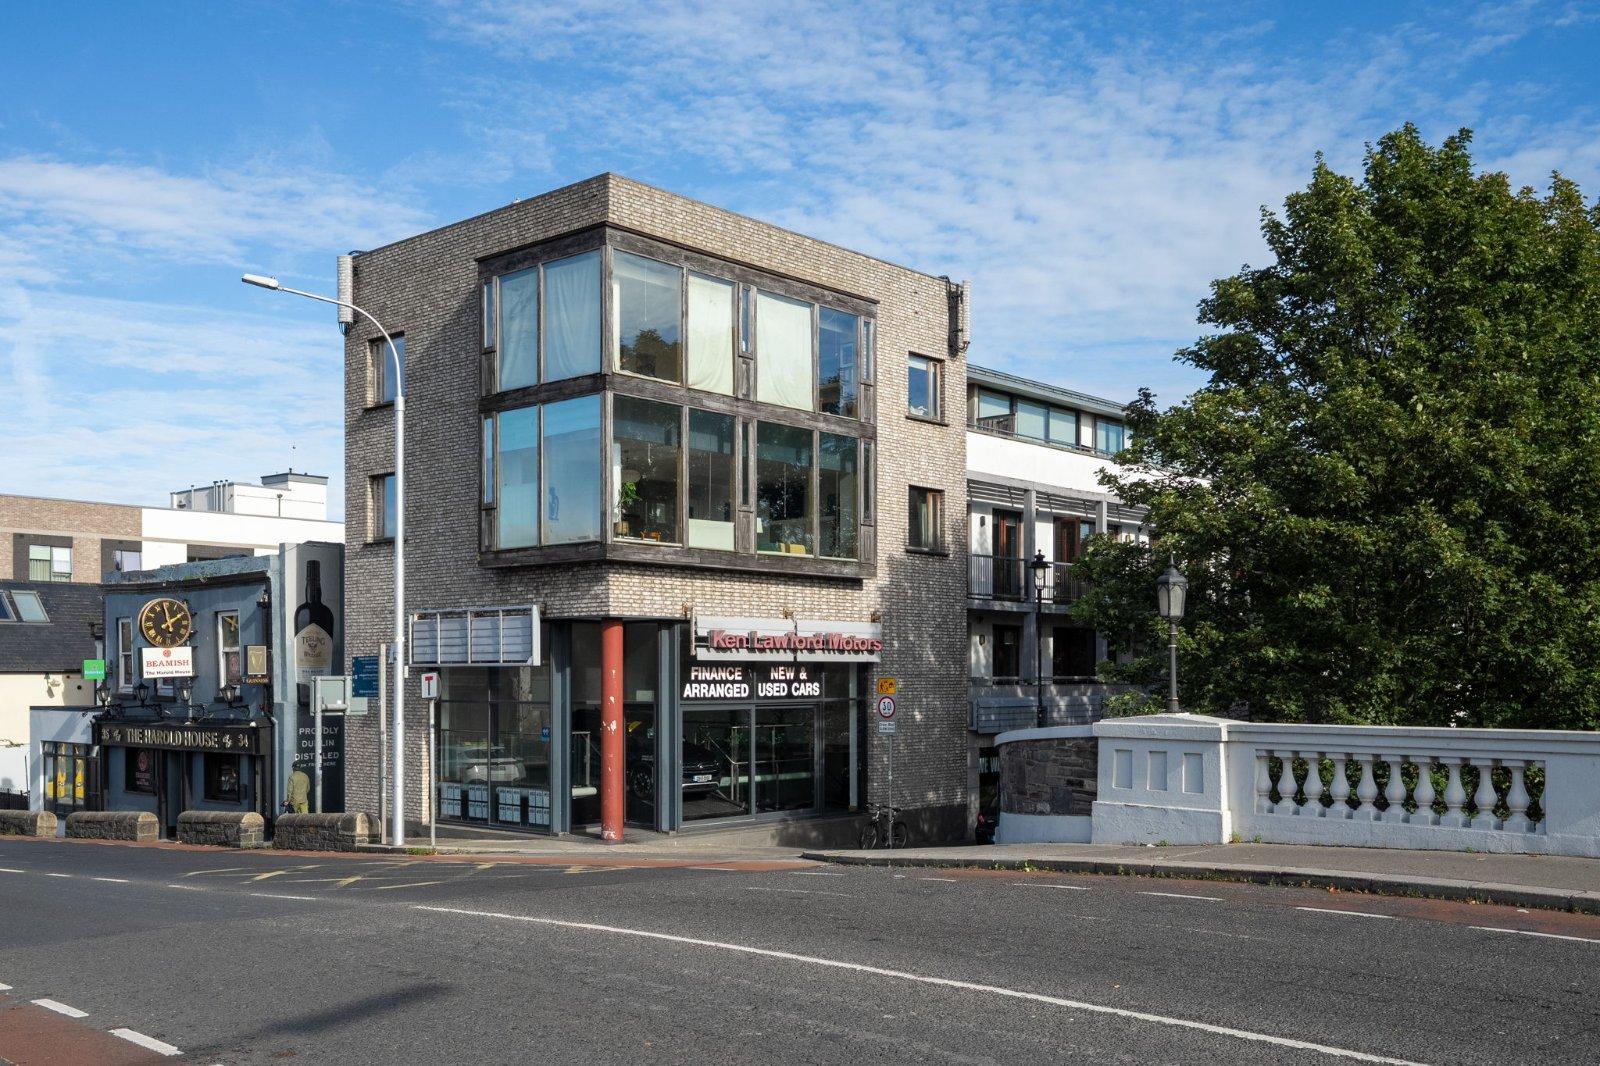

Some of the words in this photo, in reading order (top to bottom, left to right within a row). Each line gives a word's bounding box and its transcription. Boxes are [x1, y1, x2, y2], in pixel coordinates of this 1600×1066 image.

[712, 631, 746, 648] Ken
[753, 631, 823, 649] Lawford
[828, 633, 883, 651] Motors
[146, 659, 189, 667] BEAMISH
[690, 666, 742, 680] FINANCE
[770, 666, 795, 680] NEW
[799, 666, 807, 680] &
[683, 683, 749, 698] ARRANGED
[758, 683, 788, 697] USED
[791, 682, 820, 696] CARS
[882, 701, 892, 711] 30
[299, 726, 339, 735] PRODLY
[101, 728, 110, 740] 35
[125, 728, 143, 744] THE
[144, 729, 182, 746] HAROLD
[184, 731, 218, 748] HOUSE
[238, 733, 249, 747] 34
[301, 740, 335, 748] DULIN
[294, 752, 340, 761] DISTLED
